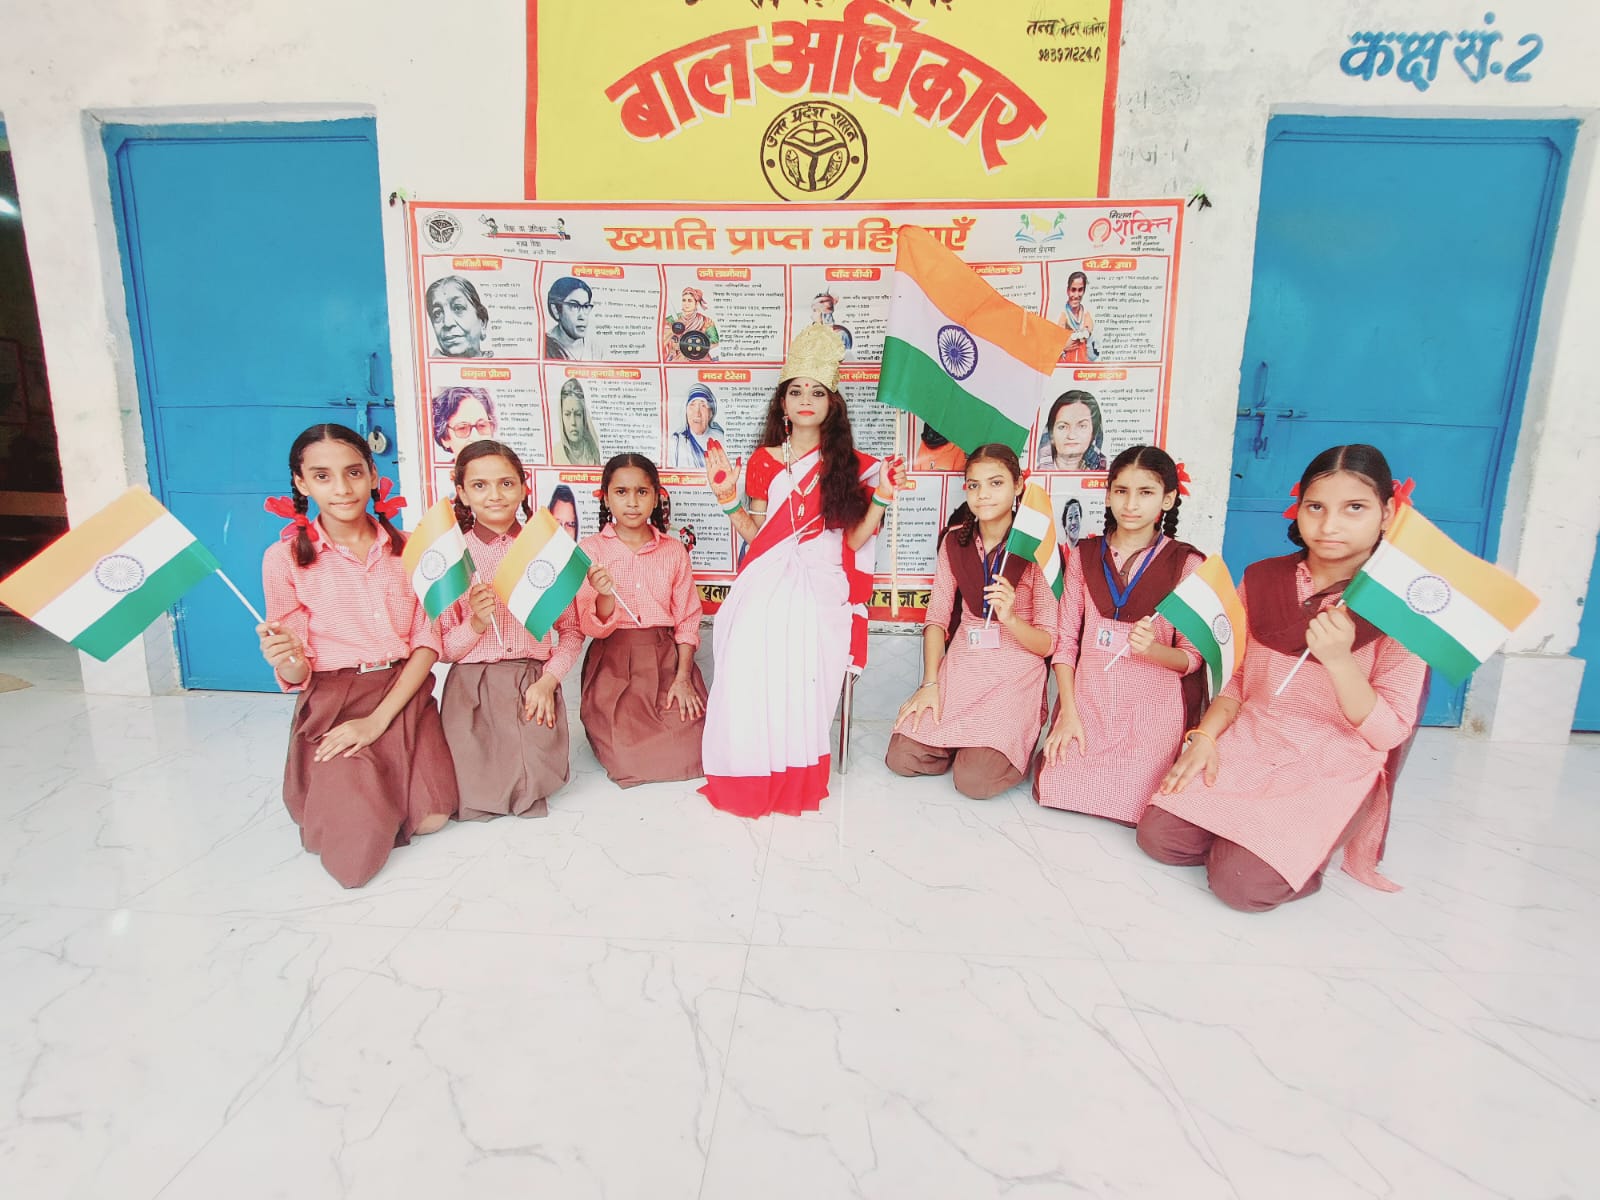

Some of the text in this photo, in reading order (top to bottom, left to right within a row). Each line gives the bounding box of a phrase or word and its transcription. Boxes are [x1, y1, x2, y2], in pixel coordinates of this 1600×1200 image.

[1339, 30, 1452, 92] कक्ष
[604, 0, 1048, 172] बाल अधिकार
[791, 103, 830, 123] प्रदेश
[604, 216, 716, 251] ख्याति
[725, 227, 814, 256] प्राप्त
[1112, 209, 1173, 245] शक्ति
[698, 267, 714, 278] रानी
[702, 369, 748, 380] मदर टेरेसा
